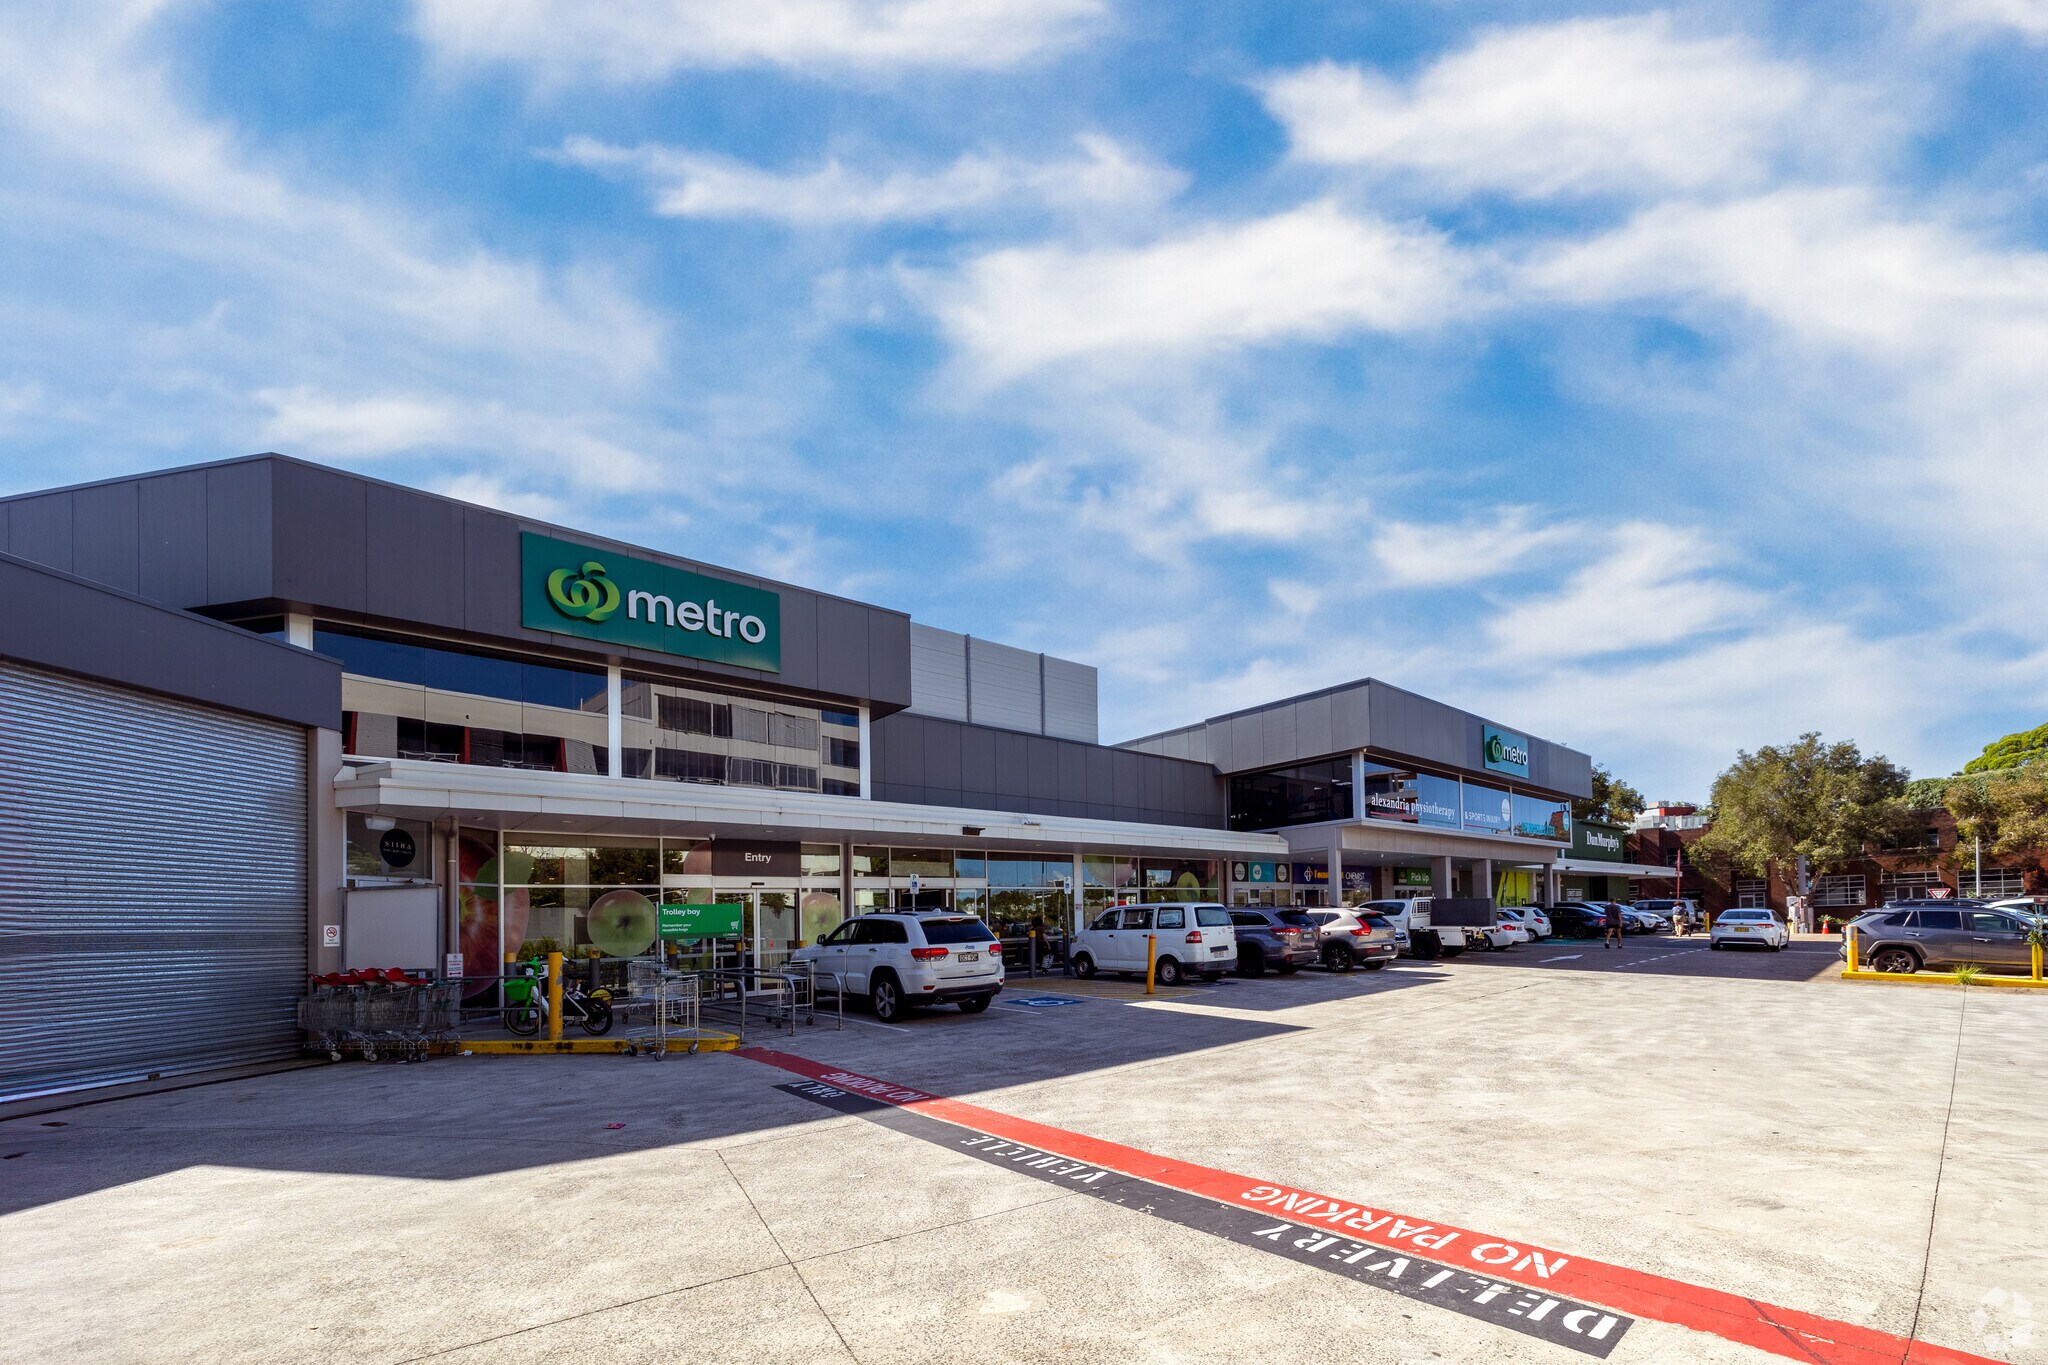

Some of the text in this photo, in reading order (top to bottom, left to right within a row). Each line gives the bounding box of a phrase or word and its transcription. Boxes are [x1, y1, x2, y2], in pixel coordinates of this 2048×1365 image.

[628, 589, 766, 644] metro
[1503, 745, 1528, 766] metro
[1371, 793, 1455, 820] alexandria physiotherapy
[1468, 811, 1486, 822] SPORTS
[1486, 814, 1501, 824] INJURY
[744, 852, 772, 864] Entry
[1345, 871, 1366, 880] CHEMIST
[1410, 872, 1430, 884] Pick Up
[662, 908, 701, 917] Trolley bay
[820, 1072, 930, 1102] NO PARKING
[960, 1135, 1108, 1184] VEHICLE
[1240, 1185, 1569, 1279] NO PARKING
[1251, 1223, 1618, 1340] DELIVERY
